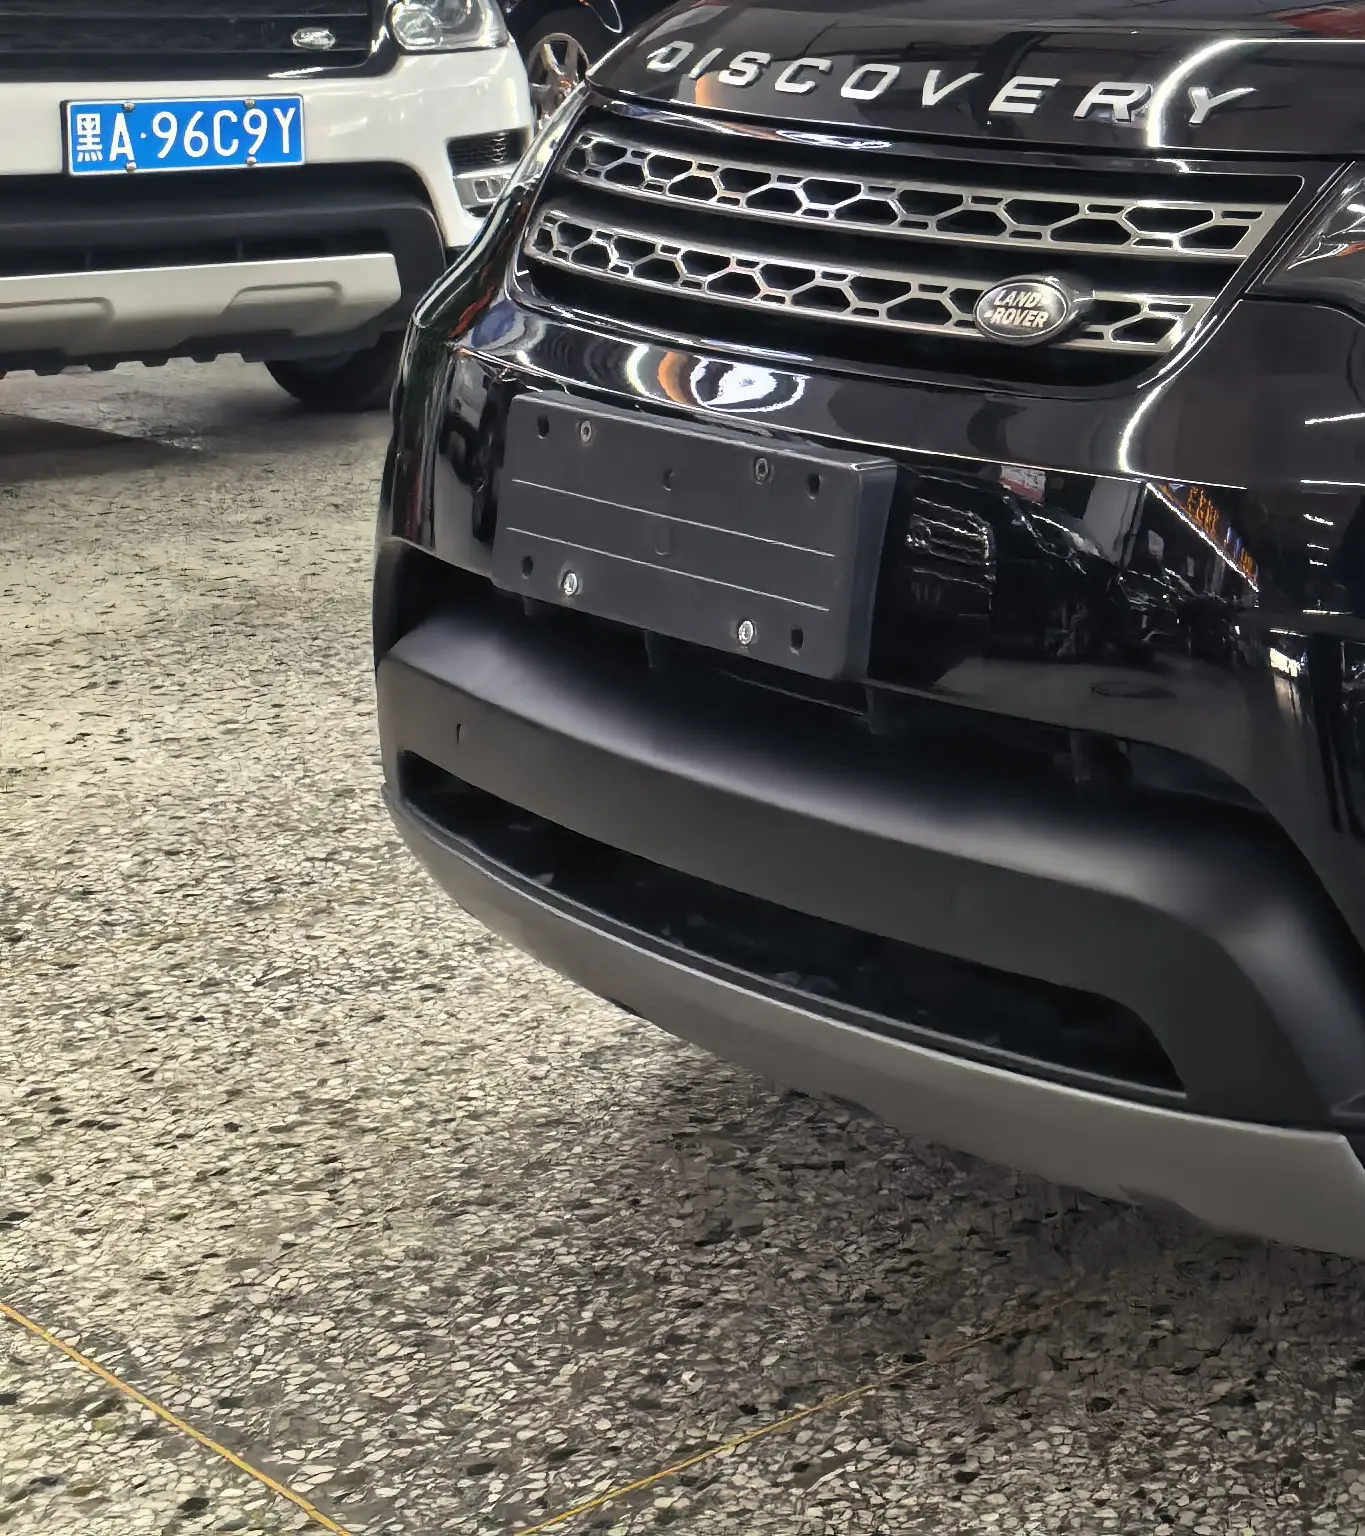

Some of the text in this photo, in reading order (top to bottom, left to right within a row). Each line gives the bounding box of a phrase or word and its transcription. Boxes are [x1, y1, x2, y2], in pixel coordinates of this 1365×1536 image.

[645, 39, 1258, 126] DISCOVERY
[75, 106, 297, 164] 黑A·96C9Y
[990, 307, 1050, 328] ROVER
